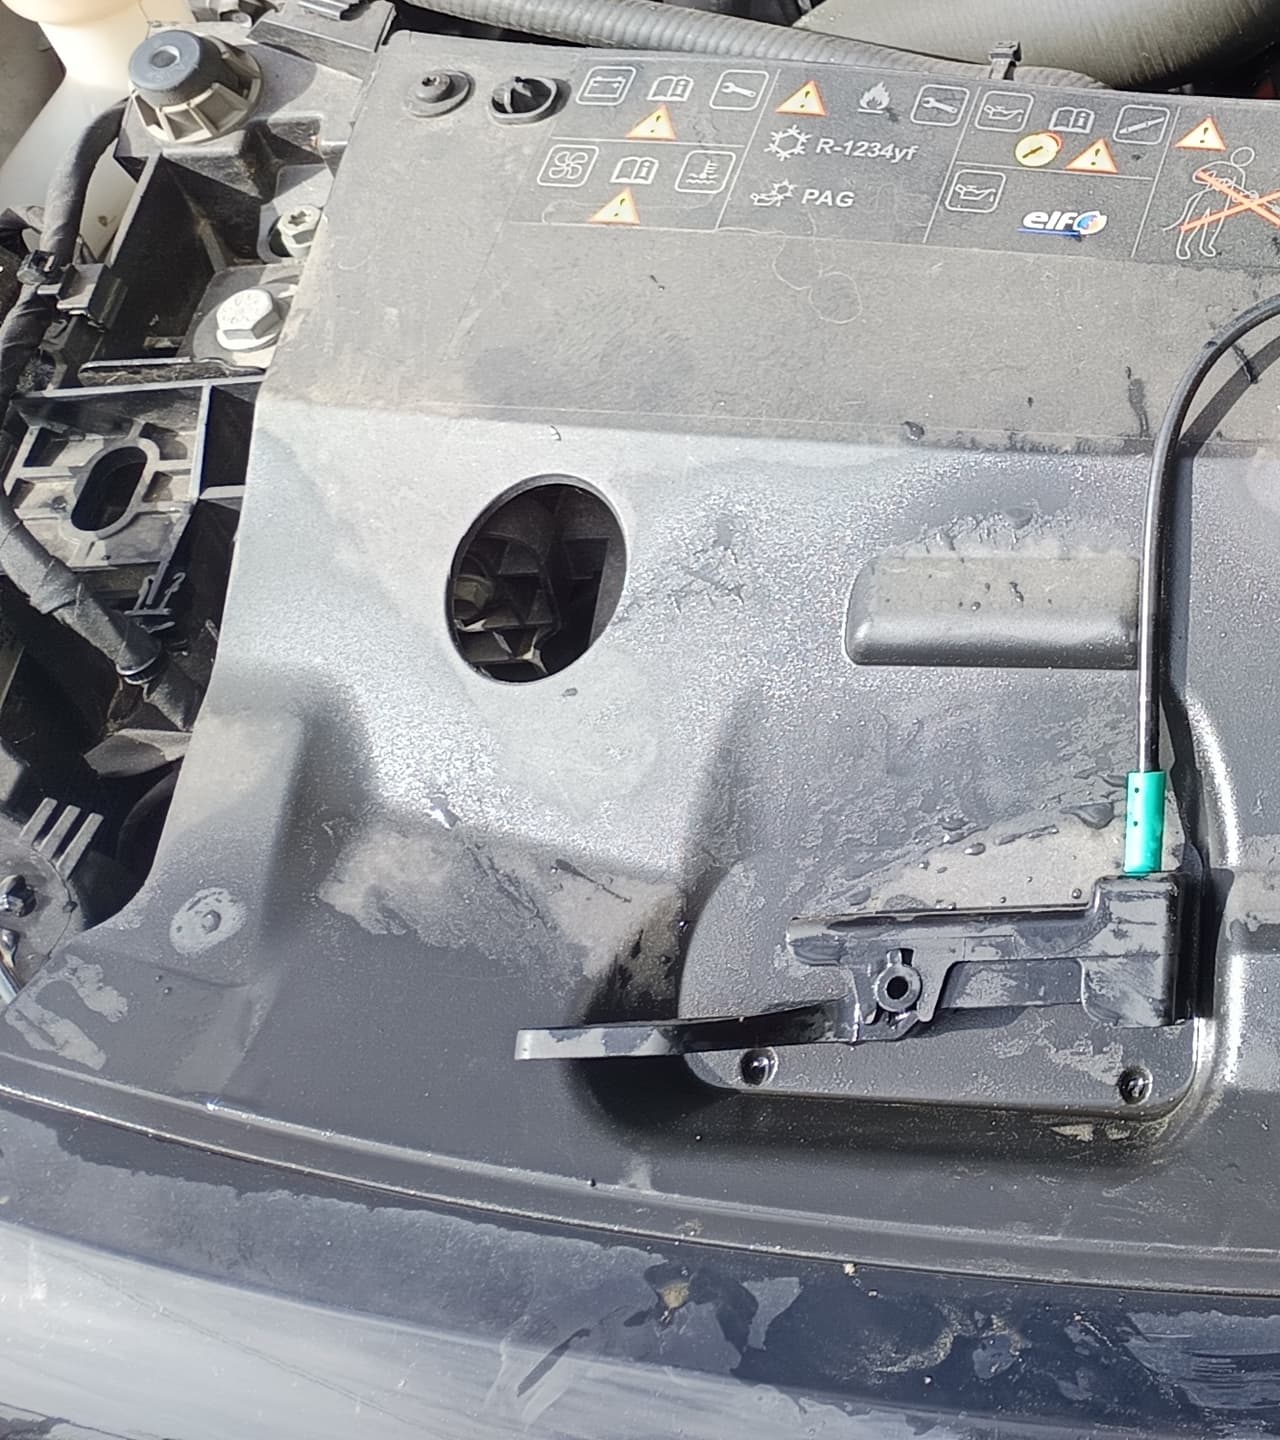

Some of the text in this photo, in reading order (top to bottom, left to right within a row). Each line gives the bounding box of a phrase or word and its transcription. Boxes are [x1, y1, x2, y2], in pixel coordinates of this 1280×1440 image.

[815, 137, 920, 163] R-1234yf
[801, 188, 855, 208] PAG
[1022, 210, 1079, 231] elf
